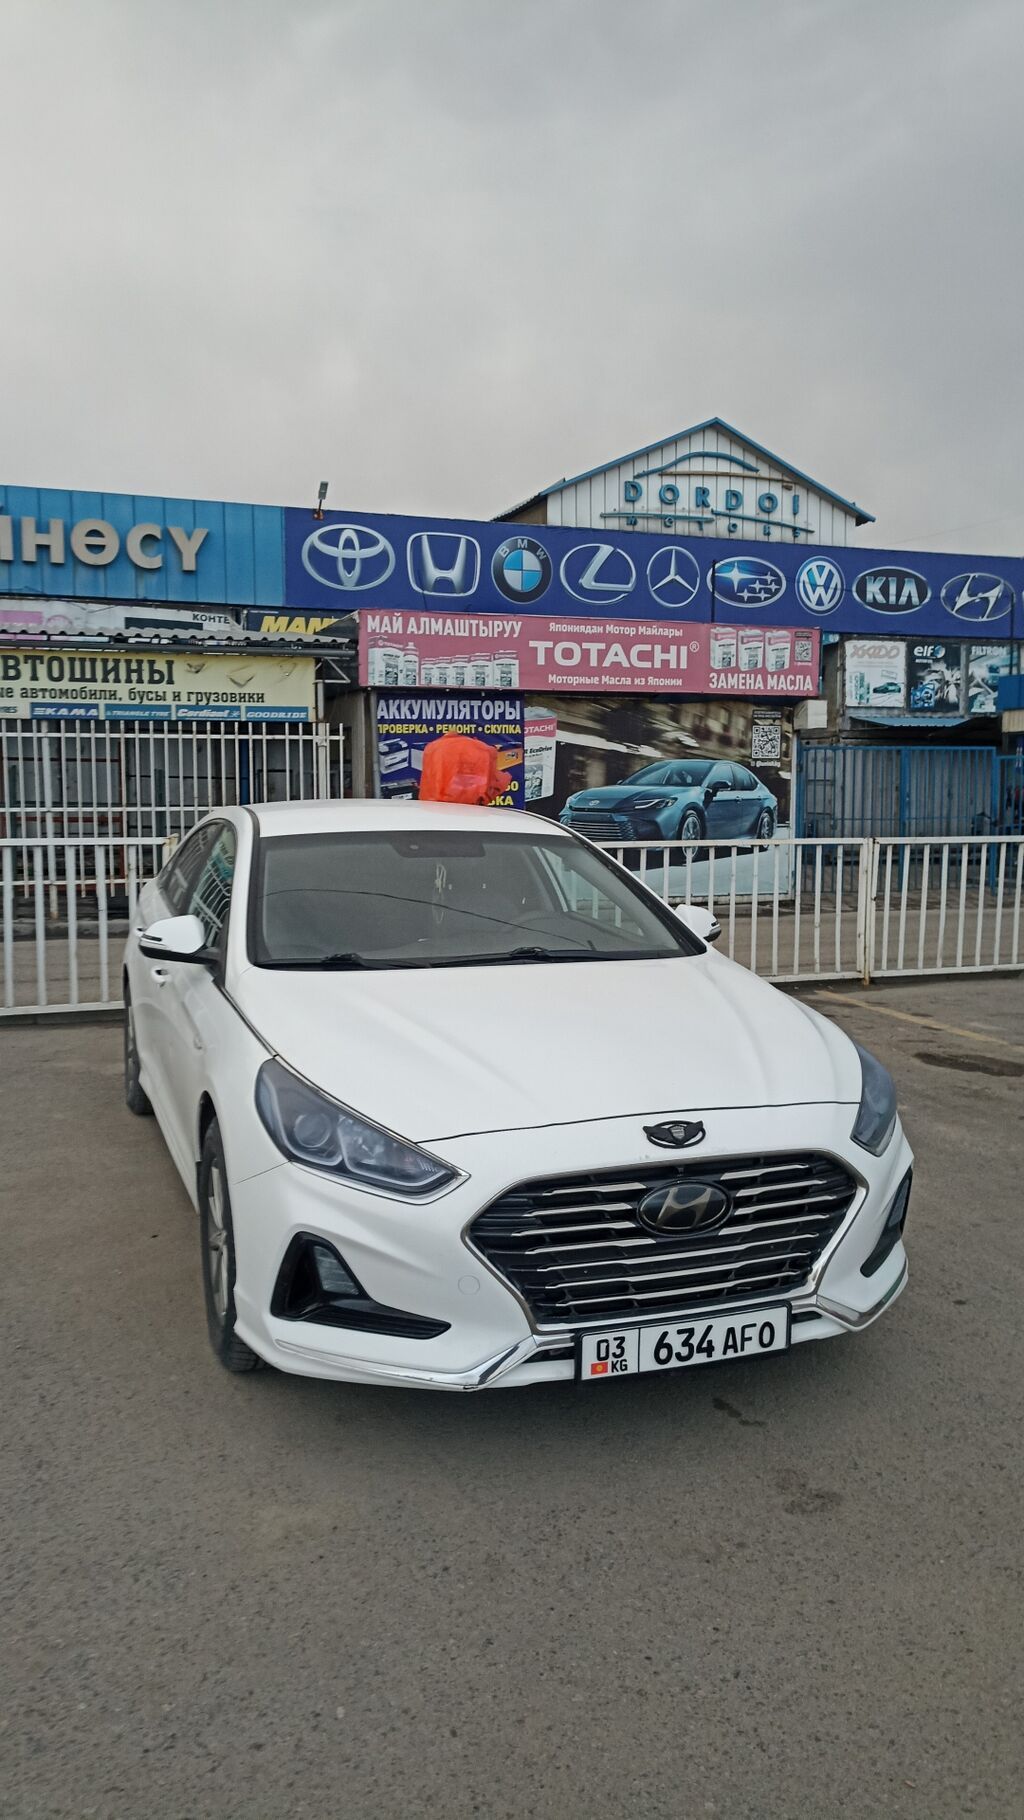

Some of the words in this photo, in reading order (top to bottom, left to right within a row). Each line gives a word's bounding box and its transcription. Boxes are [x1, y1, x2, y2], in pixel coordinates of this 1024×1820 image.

[624, 481, 800, 516] DORDOI
[498, 539, 547, 560] BMW
[866, 576, 920, 605] KIA
[367, 612, 403, 633] МАЙ
[407, 617, 522, 637] АЛМАШТЫРУУ
[549, 622, 603, 634] Япониядан
[606, 625, 636, 636] Мотор
[638, 625, 683, 638] Майлары
[913, 645, 935, 657] elf
[548, 674, 599, 685] Моторные
[601, 676, 631, 685] Масла
[648, 676, 682, 686] Японии
[709, 672, 764, 689] ЗАМЕНА
[767, 674, 813, 691] МАСЛА
[128, 687, 167, 704] бусы
[172, 691, 181, 701] и
[187, 691, 265, 705] грузовики
[45, 707, 98, 716] KAMA
[246, 711, 307, 719] GOODRIDE
[377, 700, 521, 720] АККУМУЛЯТОРЫ
[436, 724, 476, 734] РЕМОНТ
[484, 725, 522, 734] СКУПКА
[596, 1336, 626, 1361] 03
[653, 1324, 715, 1365] 634
[722, 1321, 776, 1356] AFO
[611, 1359, 628, 1373] KG
